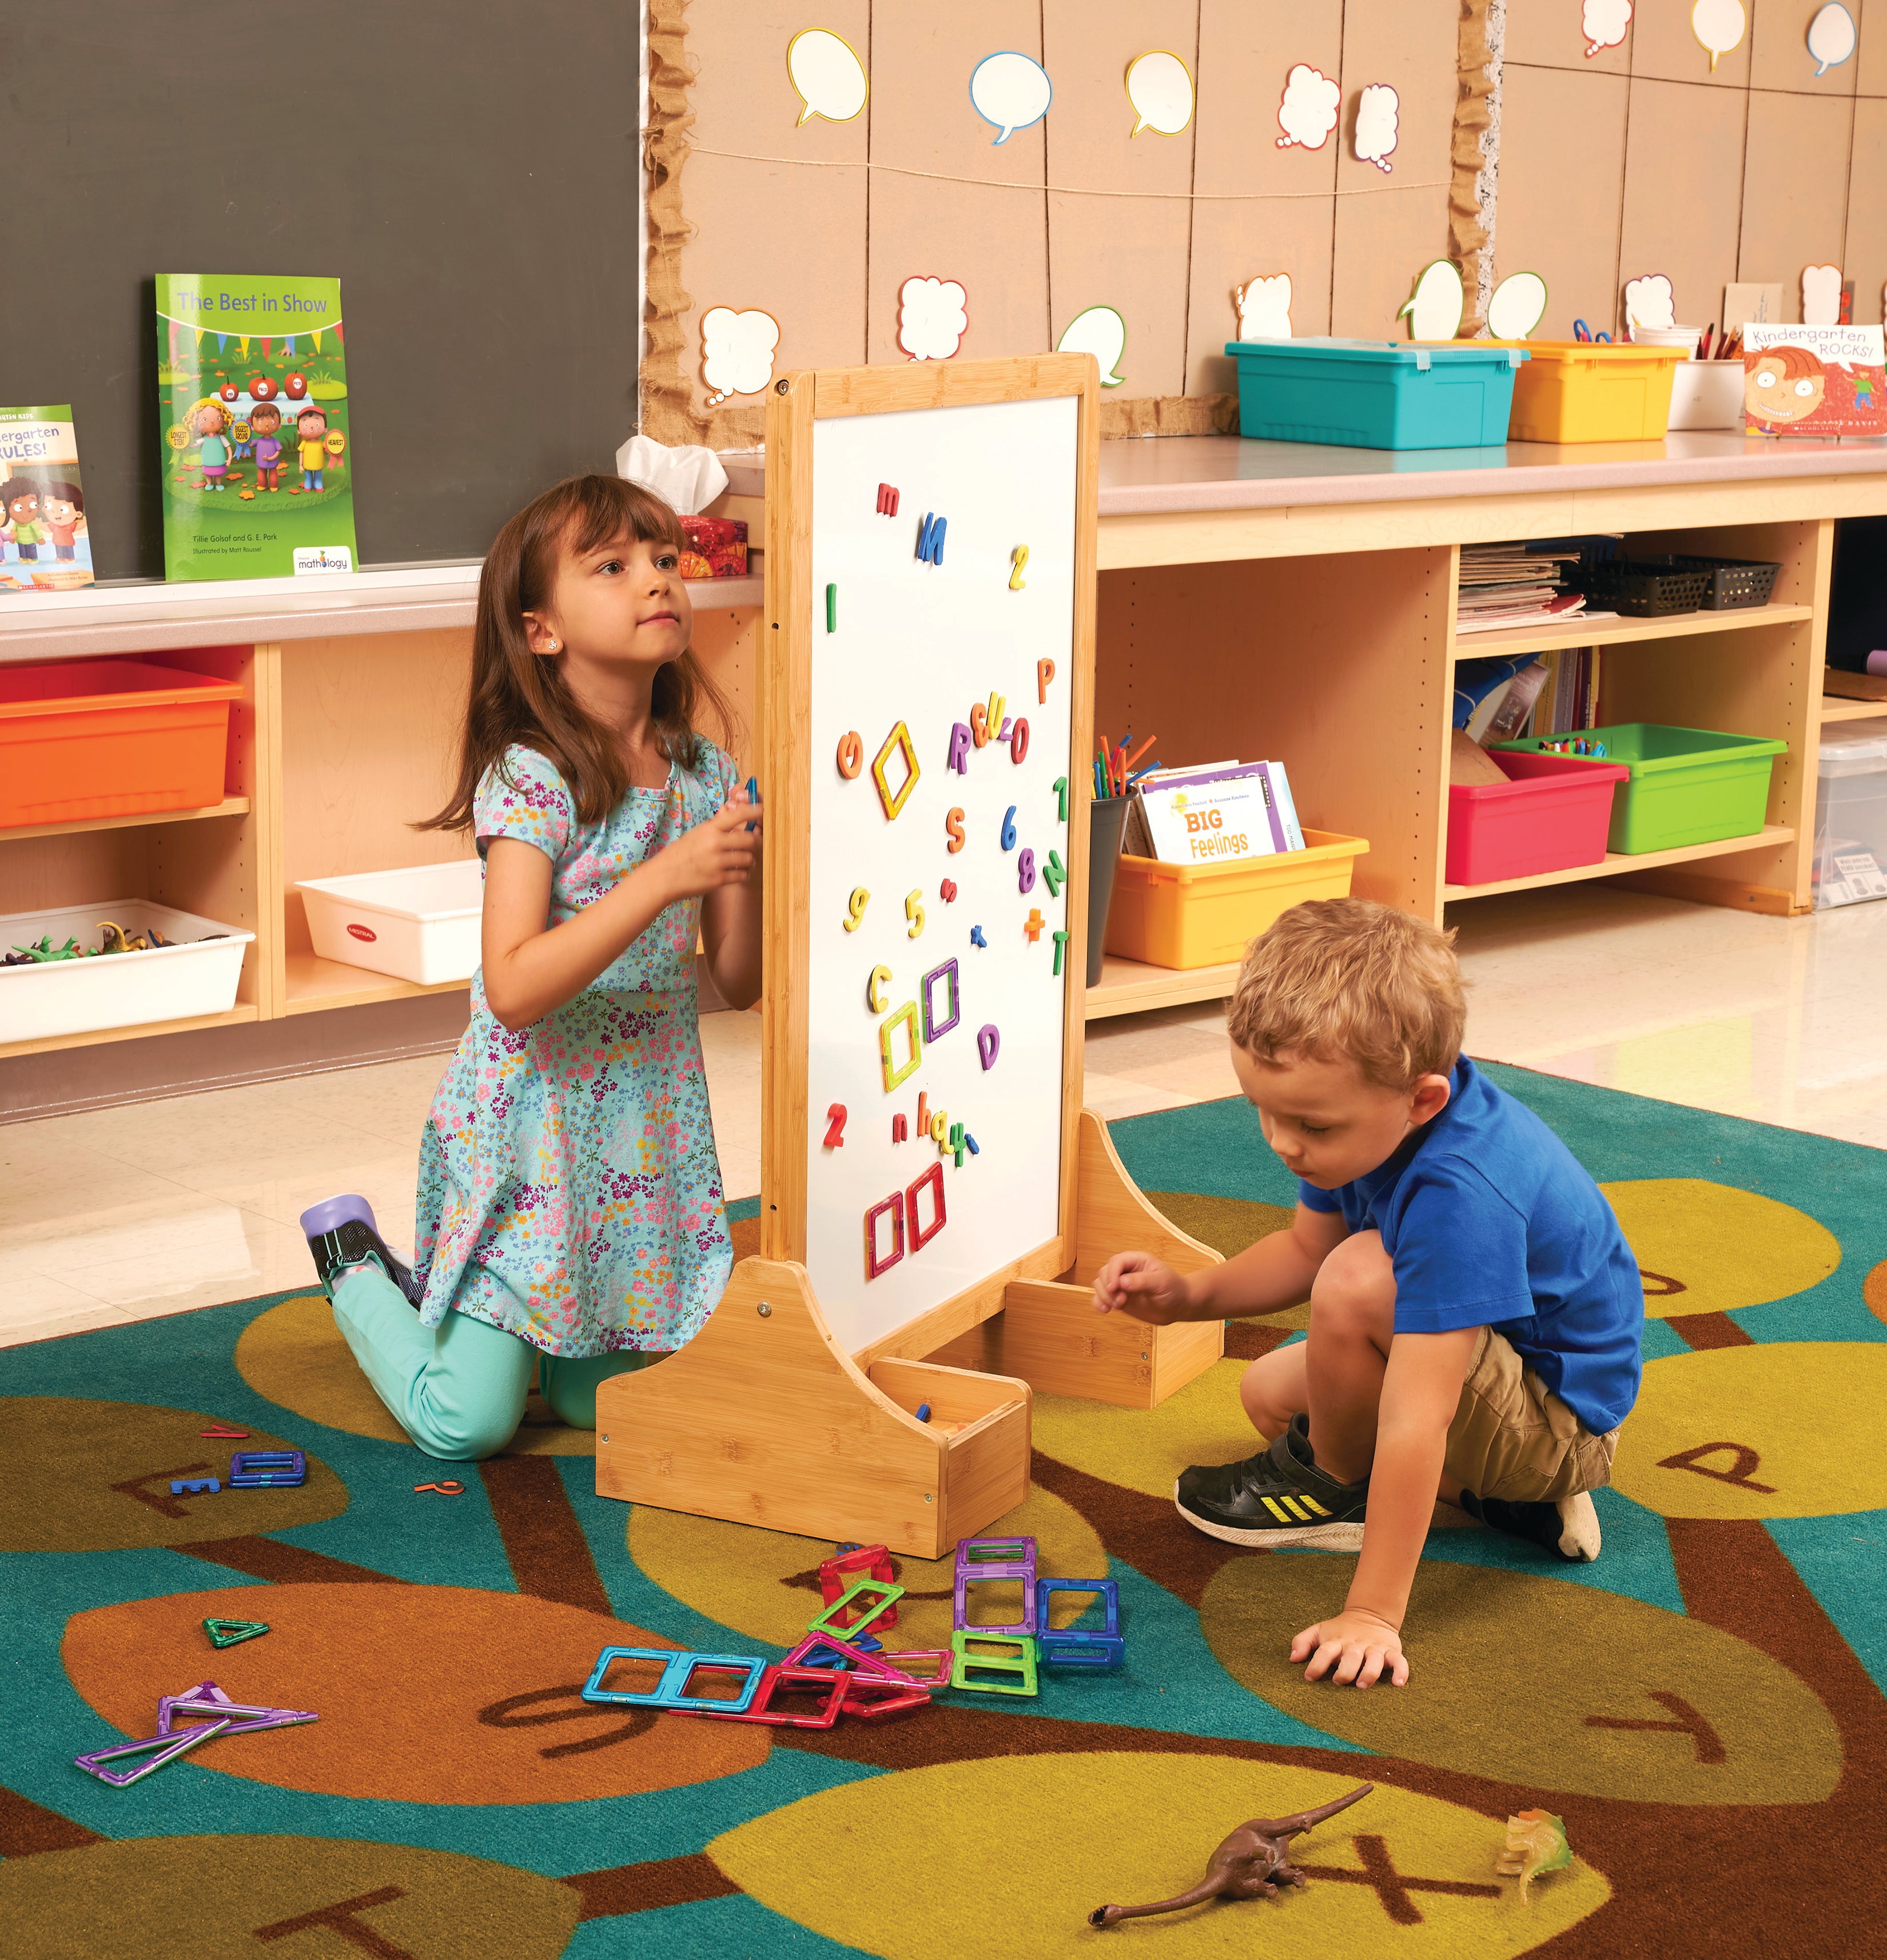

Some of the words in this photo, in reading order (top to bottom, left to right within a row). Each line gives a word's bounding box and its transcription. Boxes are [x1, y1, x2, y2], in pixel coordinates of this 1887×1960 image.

[177, 292, 213, 310] The
[220, 293, 257, 310] Best
[262, 293, 277, 311] in
[283, 294, 327, 312] Show
[1753, 328, 1866, 343] Kindergarten
[1820, 343, 1873, 357] ROCKS!
[1009, 544, 1029, 589] 2
[1038, 658, 1056, 704] P
[1002, 806, 1017, 850] 6
[1184, 809, 1223, 833] BIG
[1190, 831, 1248, 859] Feelings
[1019, 848, 1036, 893] 8
[349, 928, 375, 939] MISTRAL
[1053, 931, 1069, 975] T
[871, 965, 892, 1013] C
[823, 1104, 847, 1147] 2
[1294, 1835, 1502, 1925] X
